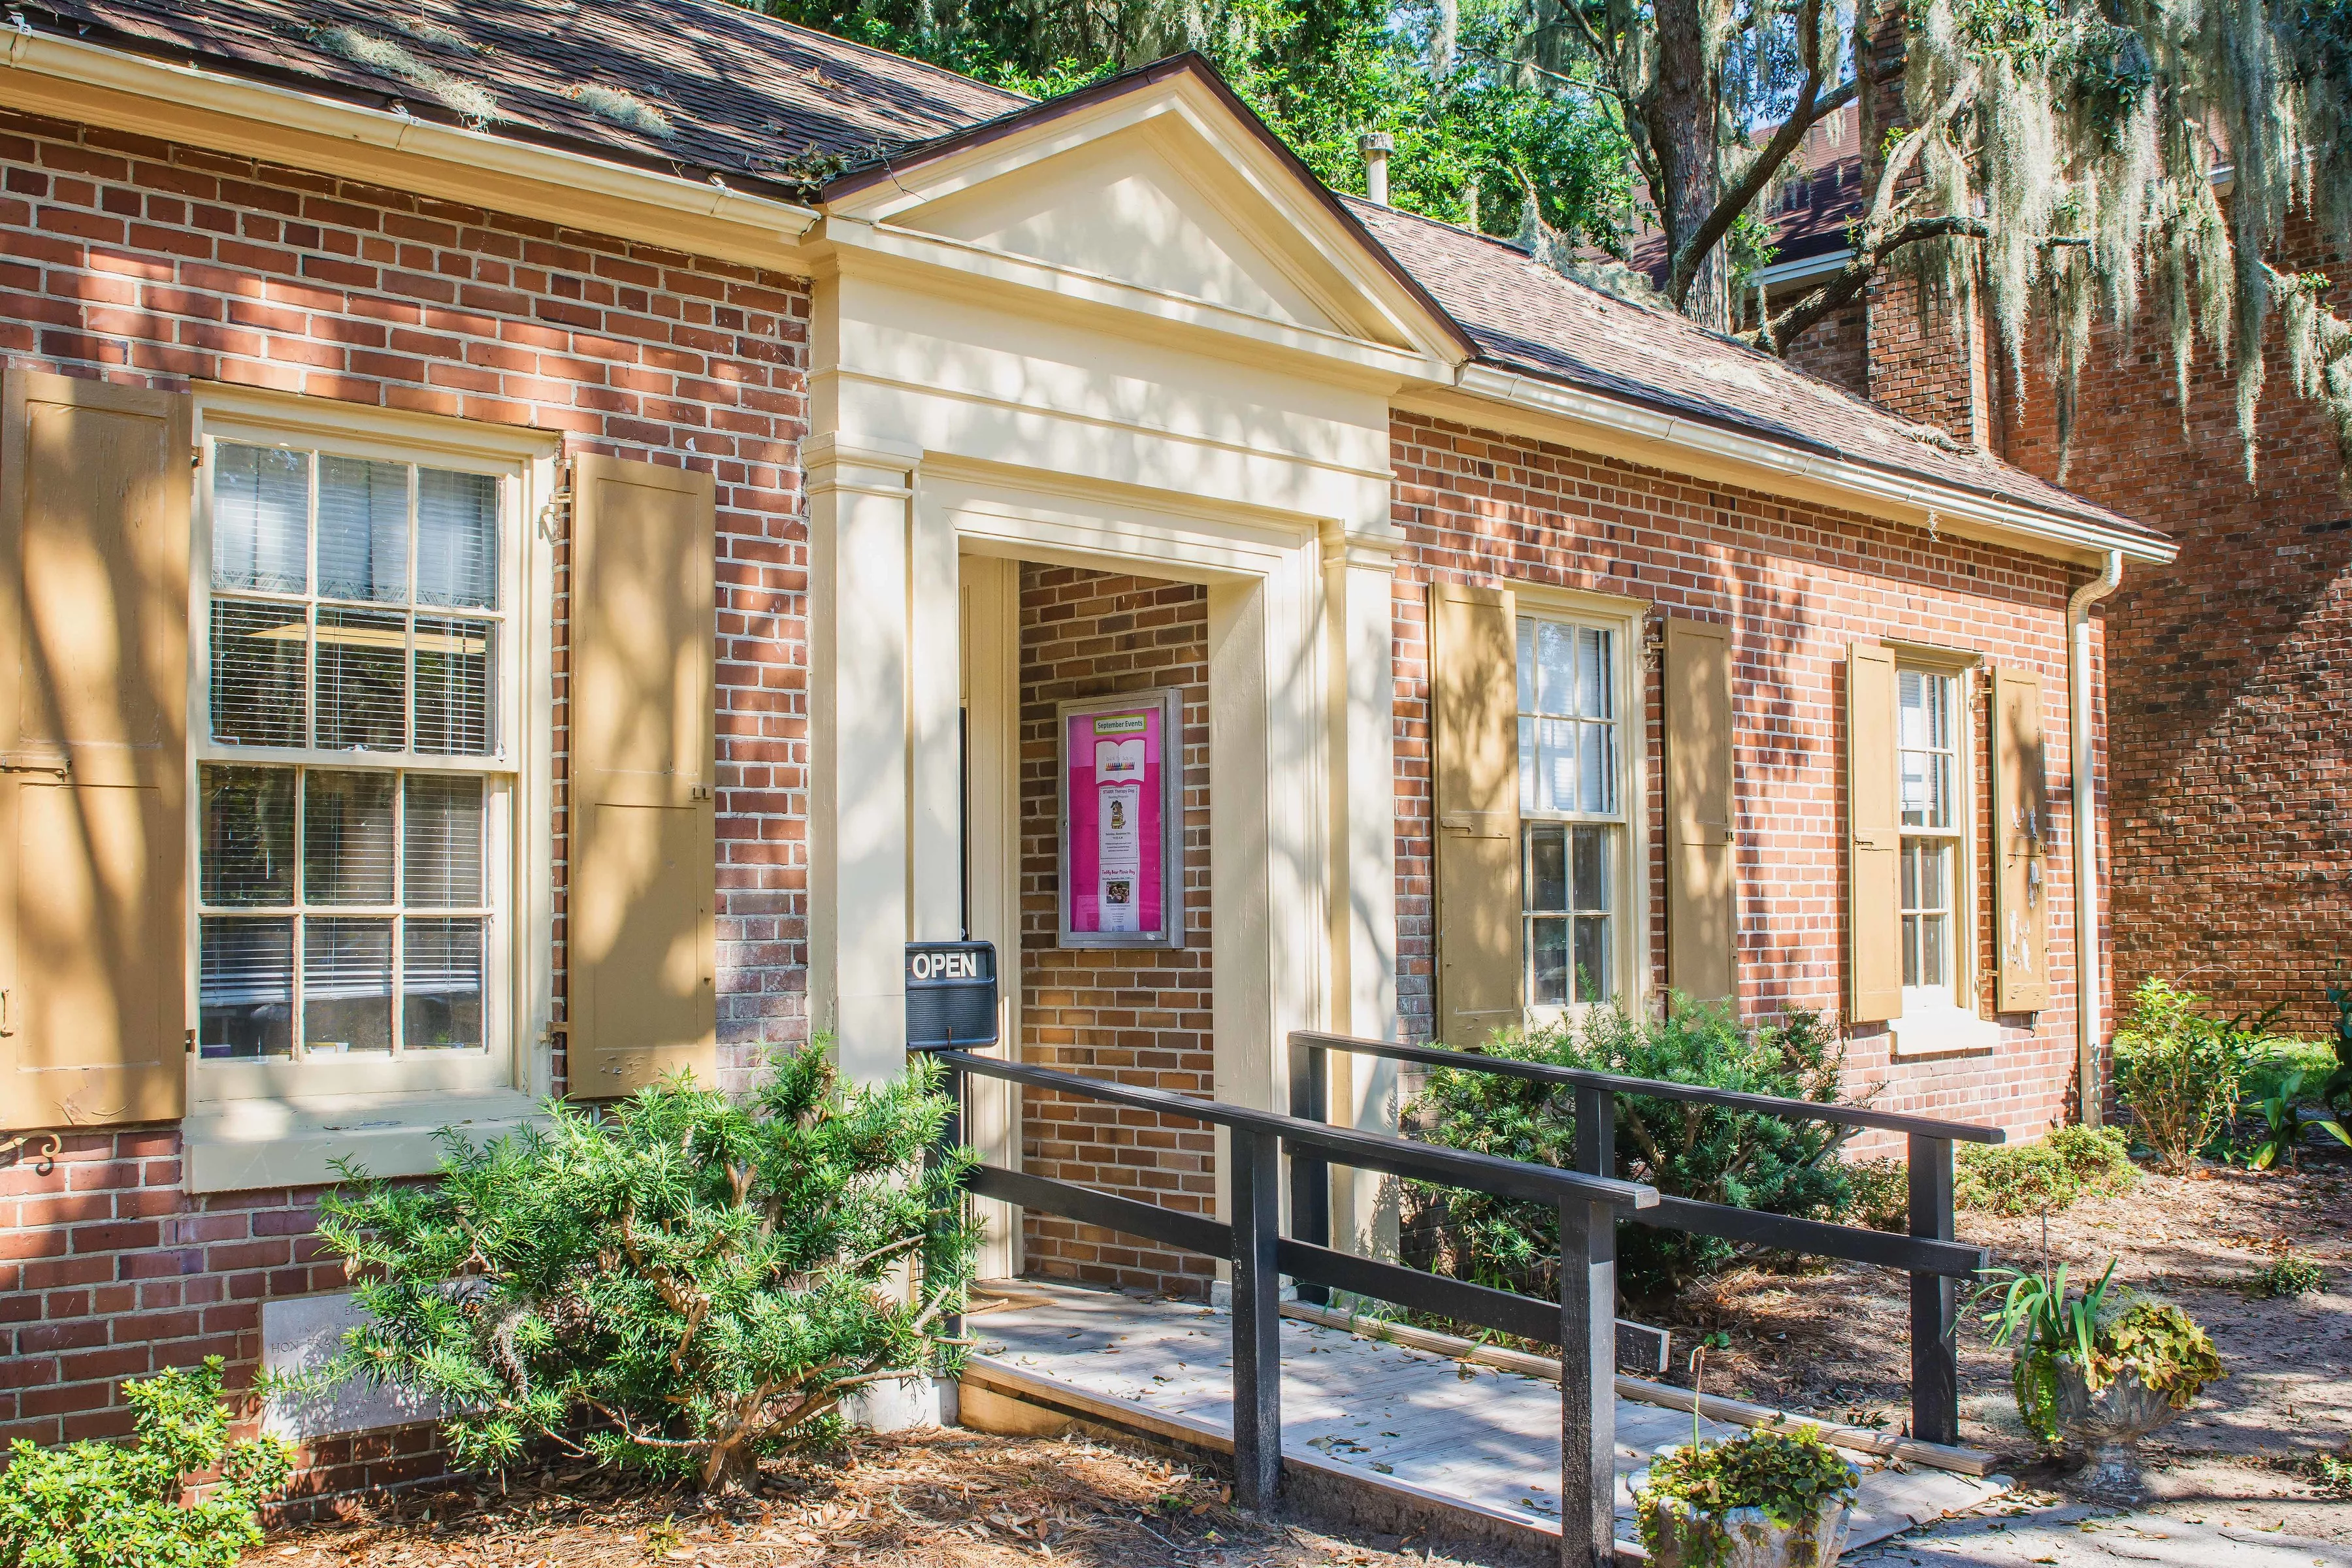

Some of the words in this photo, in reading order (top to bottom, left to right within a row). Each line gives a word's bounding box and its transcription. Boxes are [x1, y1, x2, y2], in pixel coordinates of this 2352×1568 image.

[1098, 721, 1124, 730] September
[913, 953, 977, 979] OPEN
[355, 1397, 386, 1407] TATUM
[333, 1411, 370, 1422] CANADY
